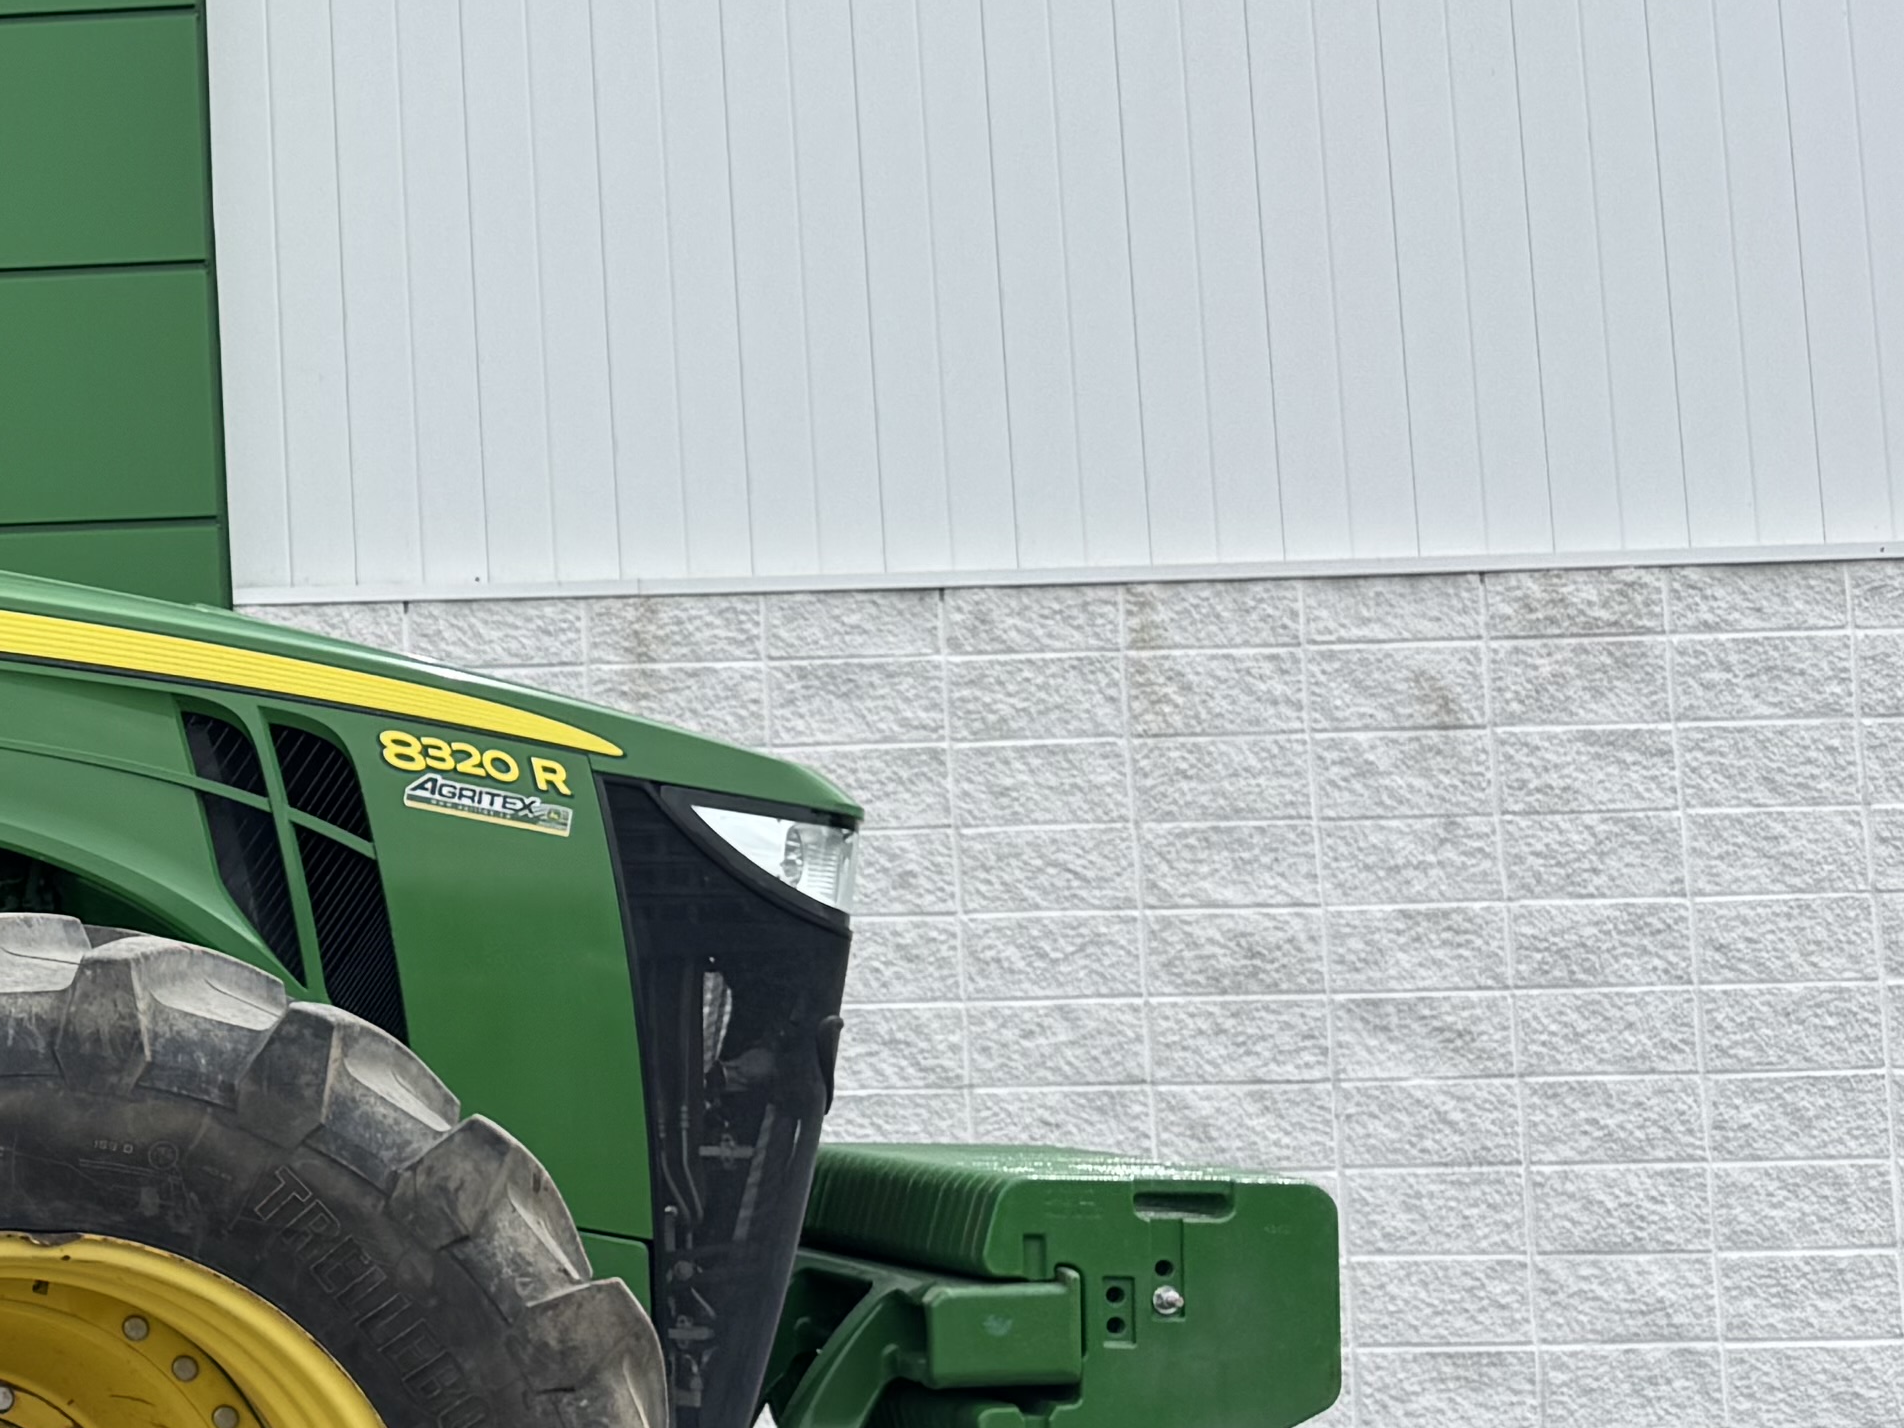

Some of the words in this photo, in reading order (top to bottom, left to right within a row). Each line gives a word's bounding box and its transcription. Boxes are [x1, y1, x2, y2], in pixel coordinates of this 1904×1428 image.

[379, 729, 520, 783] 8320
[530, 756, 573, 796] R
[409, 777, 537, 814] AGRITEX
